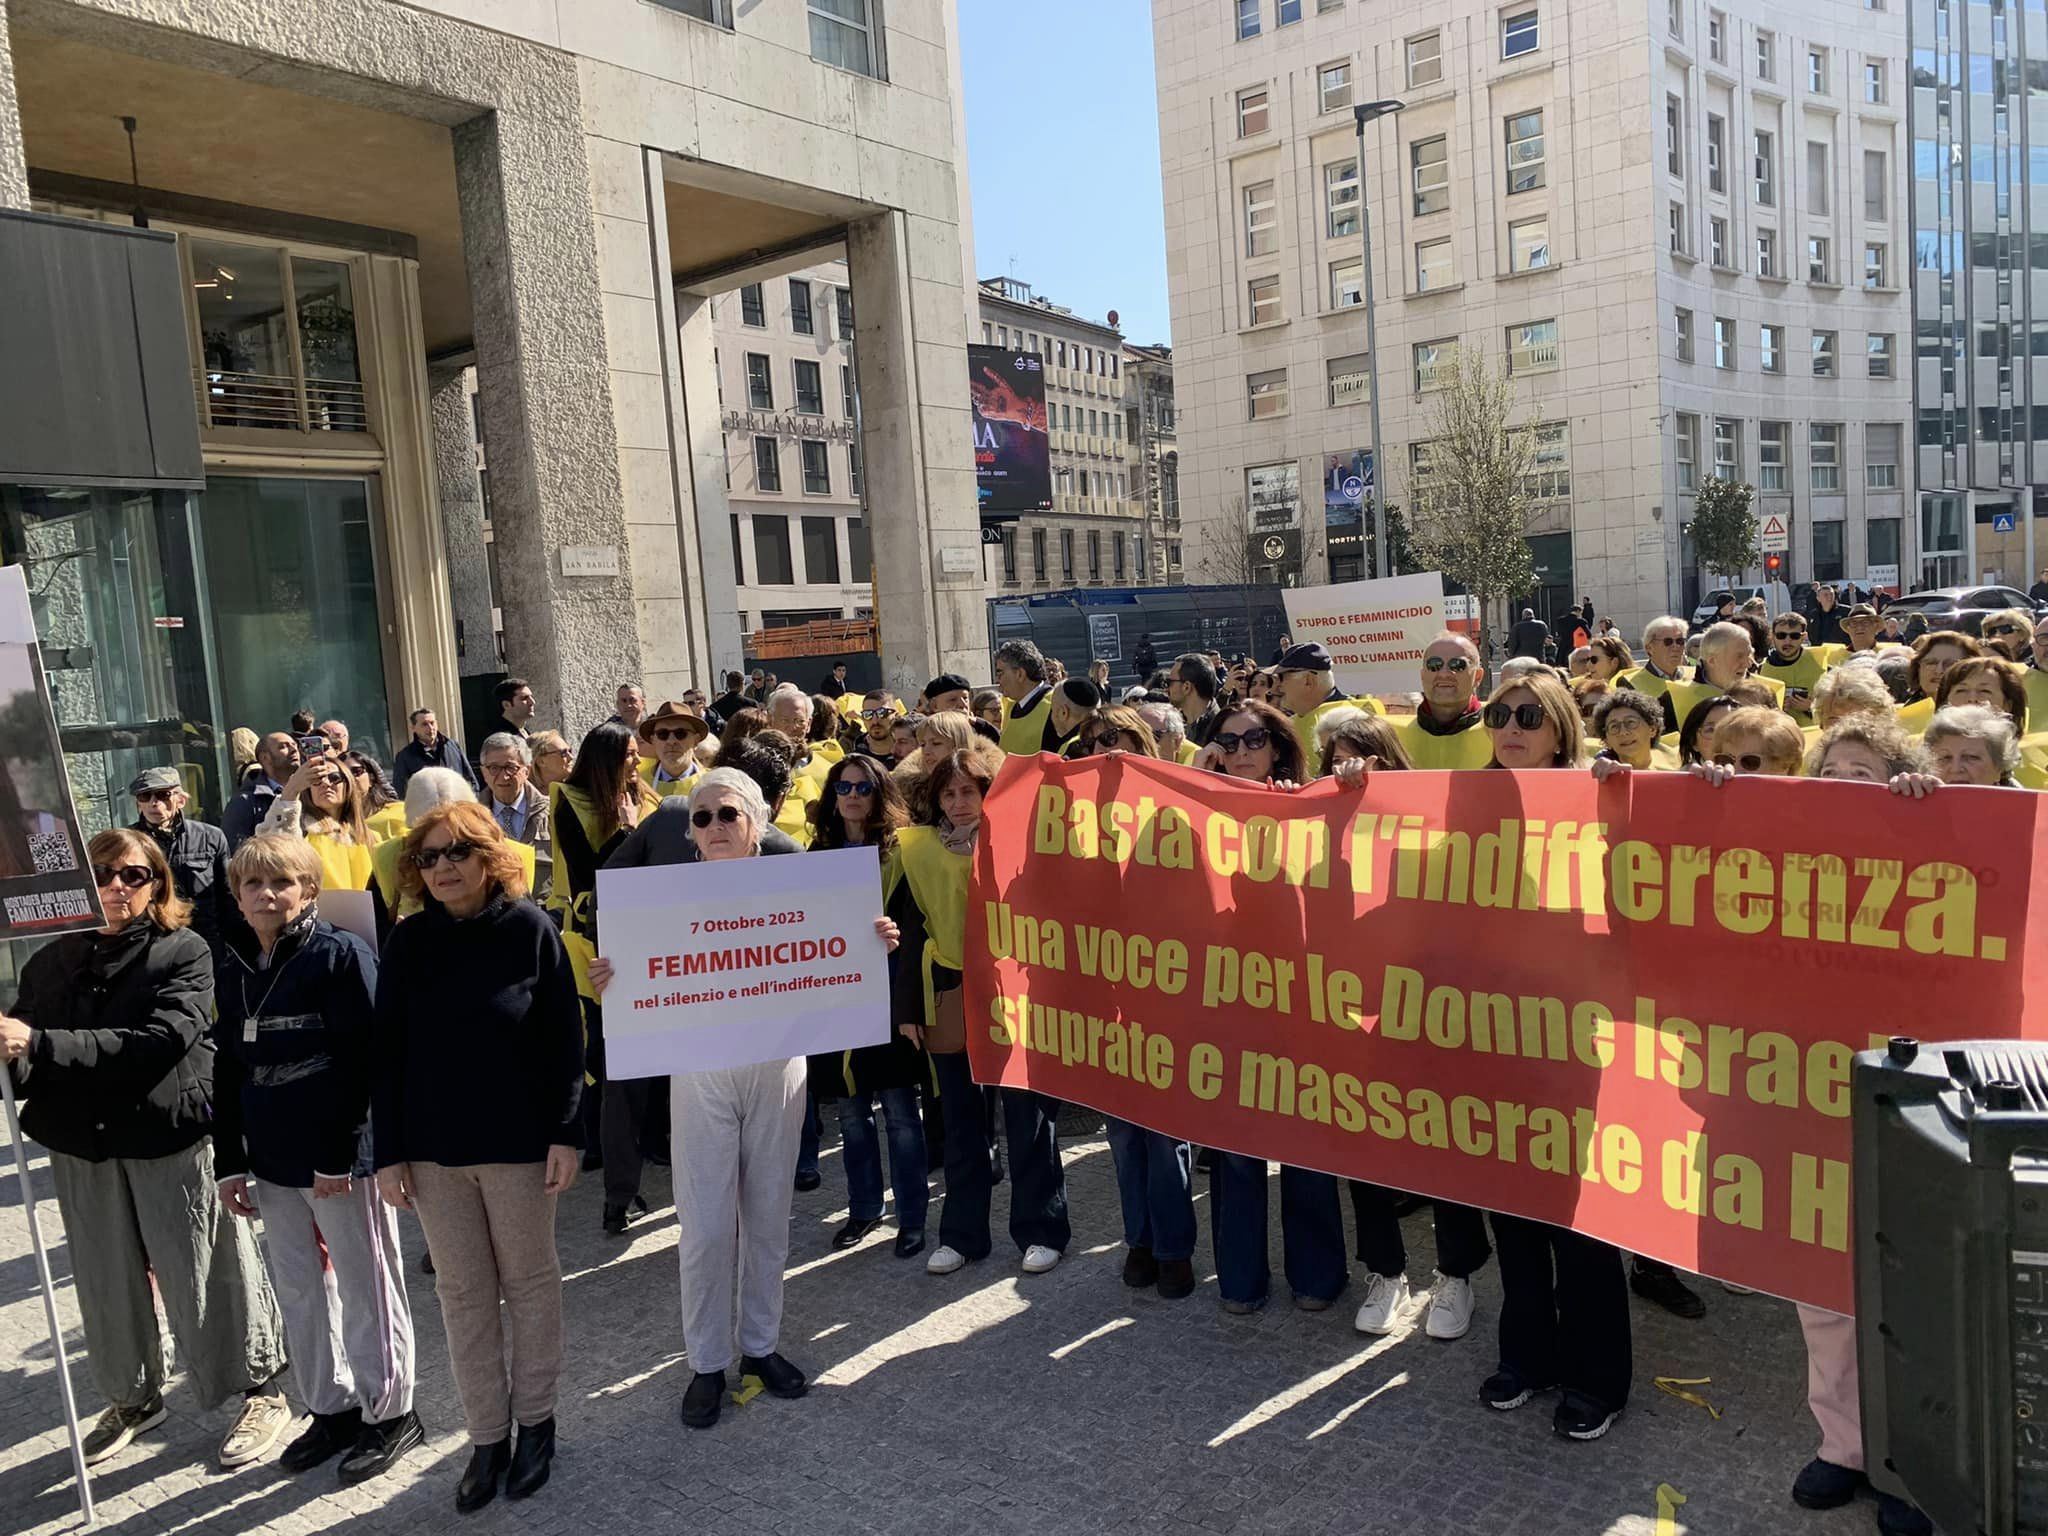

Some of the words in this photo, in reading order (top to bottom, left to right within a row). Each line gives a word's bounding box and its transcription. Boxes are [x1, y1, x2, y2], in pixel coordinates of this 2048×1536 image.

[1329, 535, 1357, 545] NORTH
[566, 561, 582, 569] SAN
[587, 560, 616, 569] BABILA
[1296, 616, 1337, 628] STUPRO
[1339, 615, 1346, 625] E
[1348, 605, 1433, 624] FEMMINICIDIO
[1326, 636, 1357, 646] SONO
[1359, 630, 1404, 644] CRIMINI
[1333, 654, 1359, 665] NTRO
[1034, 785, 1194, 871] Basta
[1205, 811, 1331, 888] con
[1351, 812, 2007, 961] l'indifferenza.
[41, 892, 56, 904] AND
[8, 904, 55, 924] FAMILIES
[54, 900, 92, 918] FORUM
[690, 922, 699, 934] 7
[704, 915, 765, 933] Ottobre
[768, 910, 805, 927] 2023
[647, 936, 847, 979] FEMMINICIDIO
[633, 995, 659, 1010] nel
[662, 988, 725, 1007] silenzio
[728, 988, 738, 999] e
[741, 972, 862, 998] nell'indifferenza
[985, 901, 1065, 971] Una
[1075, 923, 1189, 994] voce
[1202, 944, 1296, 1014] per
[1306, 953, 1365, 1031] le
[1380, 964, 1616, 1070] Donne
[1635, 996, 1889, 1118] Israe
[989, 994, 1174, 1090] stuprate
[1187, 1042, 1224, 1100] e
[1239, 1048, 1643, 1195] massacrate
[1660, 1130, 1764, 1232] da
[1790, 1152, 1849, 1253] H
